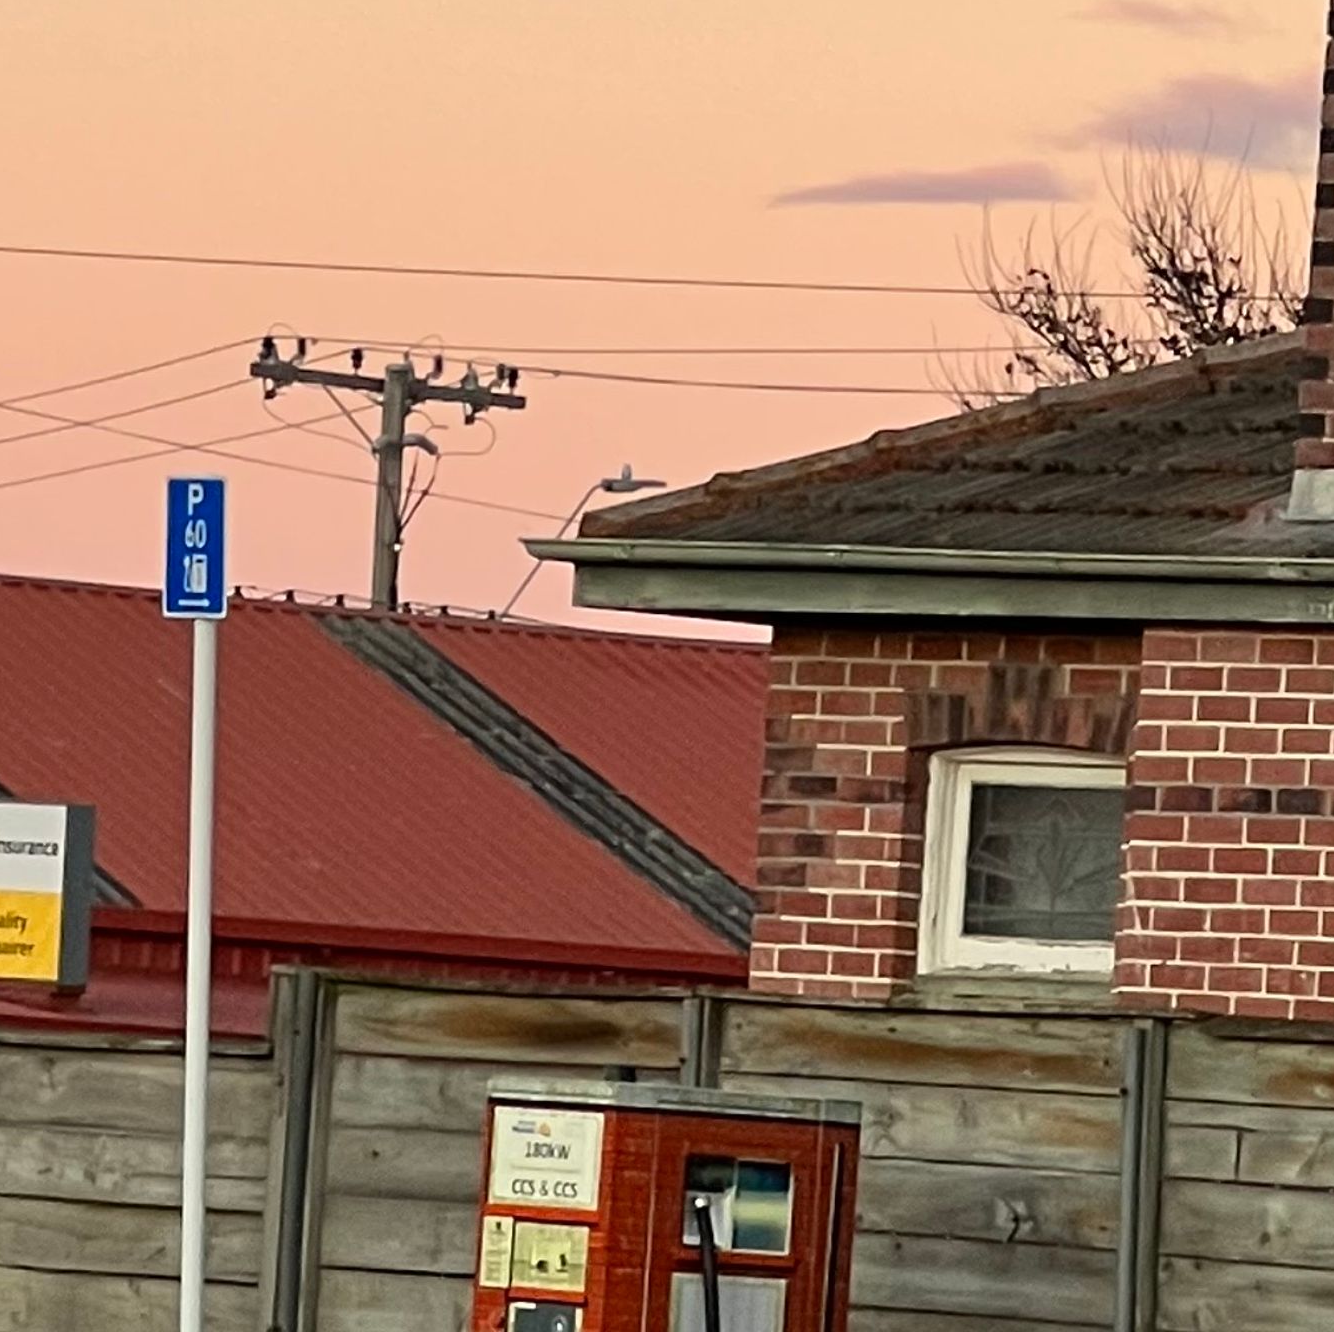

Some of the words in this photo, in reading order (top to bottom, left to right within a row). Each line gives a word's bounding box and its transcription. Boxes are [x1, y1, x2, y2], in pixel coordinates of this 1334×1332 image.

[187, 482, 204, 516] P
[184, 519, 207, 548] 60
[524, 1140, 571, 1160] 180kW
[511, 1178, 535, 1196] CCS
[553, 1181, 578, 1198] CCS
